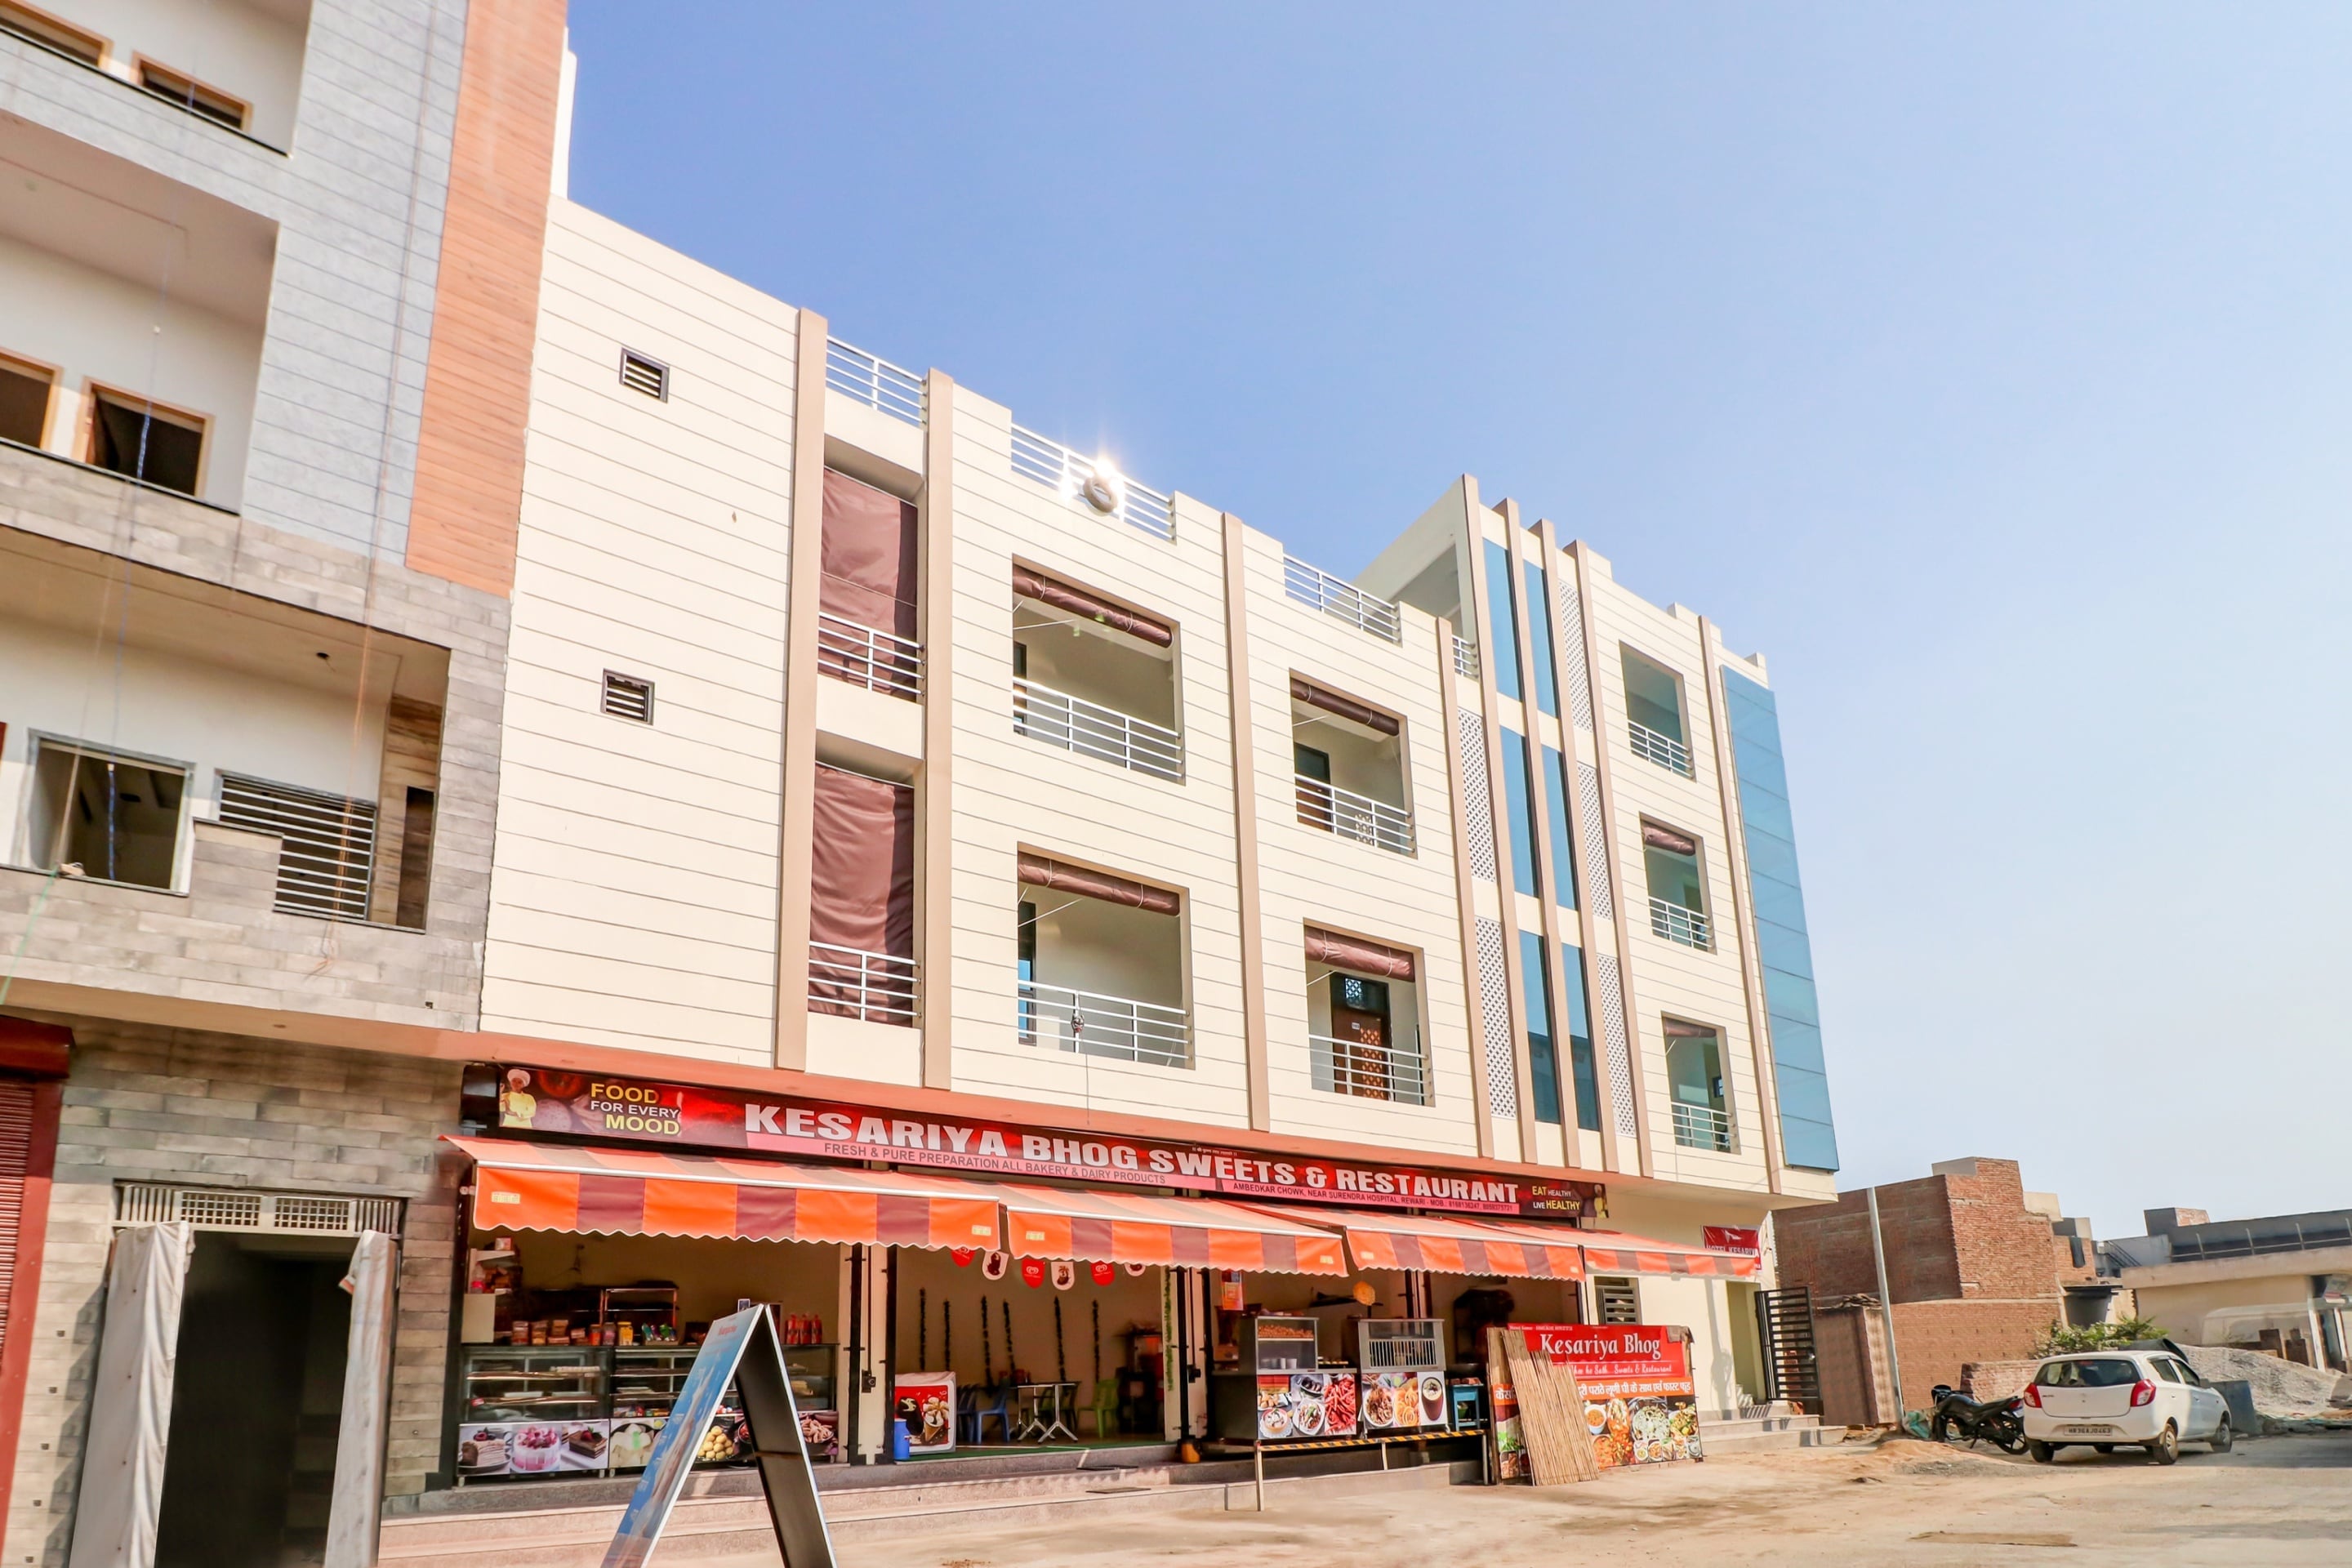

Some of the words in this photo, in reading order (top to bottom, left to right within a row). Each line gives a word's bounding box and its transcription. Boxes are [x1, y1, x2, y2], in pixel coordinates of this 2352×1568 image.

[590, 1083, 660, 1104] FOOD
[590, 1100, 624, 1113] FOR
[628, 1104, 679, 1119] EVERY
[605, 1113, 680, 1135] MOOD
[745, 1103, 1009, 1158] KESARIYA
[1022, 1134, 1139, 1171] BHOG
[1148, 1149, 1297, 1185] SWEETS
[1306, 1166, 1328, 1189] &
[1335, 1169, 1519, 1204] RESTAURANT
[824, 1143, 866, 1157] FRESH
[871, 1147, 880, 1158] &
[883, 1148, 915, 1162] PURE
[919, 1152, 1000, 1169] PREPARATION
[1001, 1159, 1022, 1171] ALL
[1025, 1162, 1069, 1177] BAKERY
[1071, 1167, 1079, 1178] &
[1080, 1168, 1111, 1180] DAIRY
[1113, 1170, 1166, 1185] PRODUCTS
[1232, 1183, 1276, 1194] AMBEDKAR
[1307, 1189, 1327, 1198] NEAR
[1329, 1191, 1365, 1201] SURENDRA
[1531, 1186, 1547, 1196] EAT
[1548, 1189, 1572, 1197] HEALTHY
[1533, 1201, 1545, 1209] LIVE
[1546, 1200, 1580, 1210] HEALTHY
[1540, 1334, 1619, 1361] Kesariya
[1624, 1333, 1662, 1361] Bhog
[1642, 1363, 1673, 1374] Restaurant
